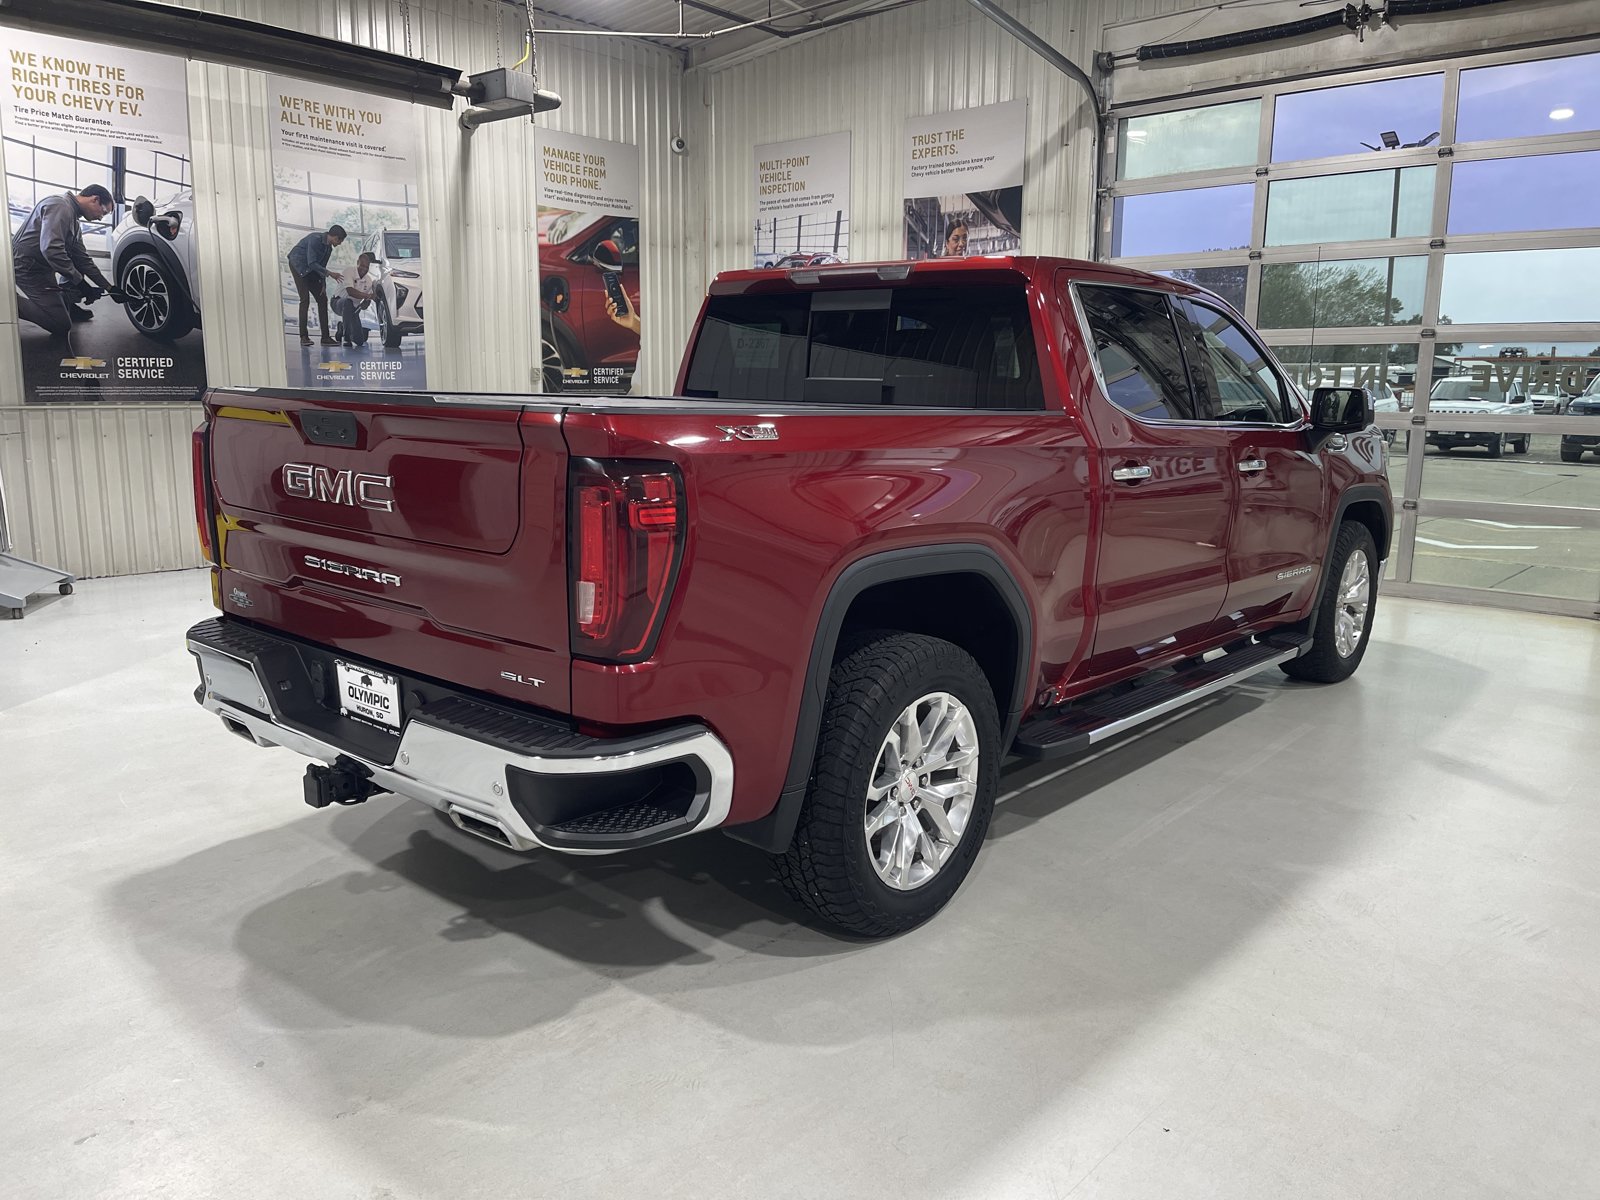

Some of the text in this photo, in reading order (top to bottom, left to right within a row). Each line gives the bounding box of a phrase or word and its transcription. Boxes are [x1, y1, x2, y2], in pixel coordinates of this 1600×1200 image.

[9, 49, 126, 82] WE KNOW THE
[11, 67, 144, 102] RIGHT TIRES FOR
[12, 84, 142, 117] YOUR CHEVY EV.
[14, 105, 112, 126] Tire Price Match Guarantee.
[280, 95, 382, 125] WE'RE WITH YOU
[280, 111, 364, 136] ALL THE WAY.
[281, 129, 294, 137] Your
[296, 132, 308, 140] first
[310, 135, 345, 146] maintenance
[912, 128, 964, 146] TRUST THE
[544, 146, 606, 166] MANAGE YOUR
[912, 144, 958, 160] EXPERTS.
[544, 159, 606, 179] VEHICLE FROM
[760, 156, 810, 172] MULTI-POINT
[911, 164, 927, 172] Factory
[544, 171, 602, 190] YOUR PHONE.
[760, 171, 792, 183] VEHICLE
[760, 181, 806, 196] INSPECTION
[117, 357, 173, 368] CERTIFIED
[360, 362, 402, 370] CERTIFIED
[118, 369, 165, 379] SERVICE
[360, 372, 396, 380] SERVICE
[282, 463, 394, 512] GMC
[304, 554, 402, 587] SIERRA
[1276, 566, 1312, 581] SIERRA
[500, 670, 546, 688] SLT
[348, 686, 390, 710] OLYMPIC
[356, 704, 374, 718] HURON,
